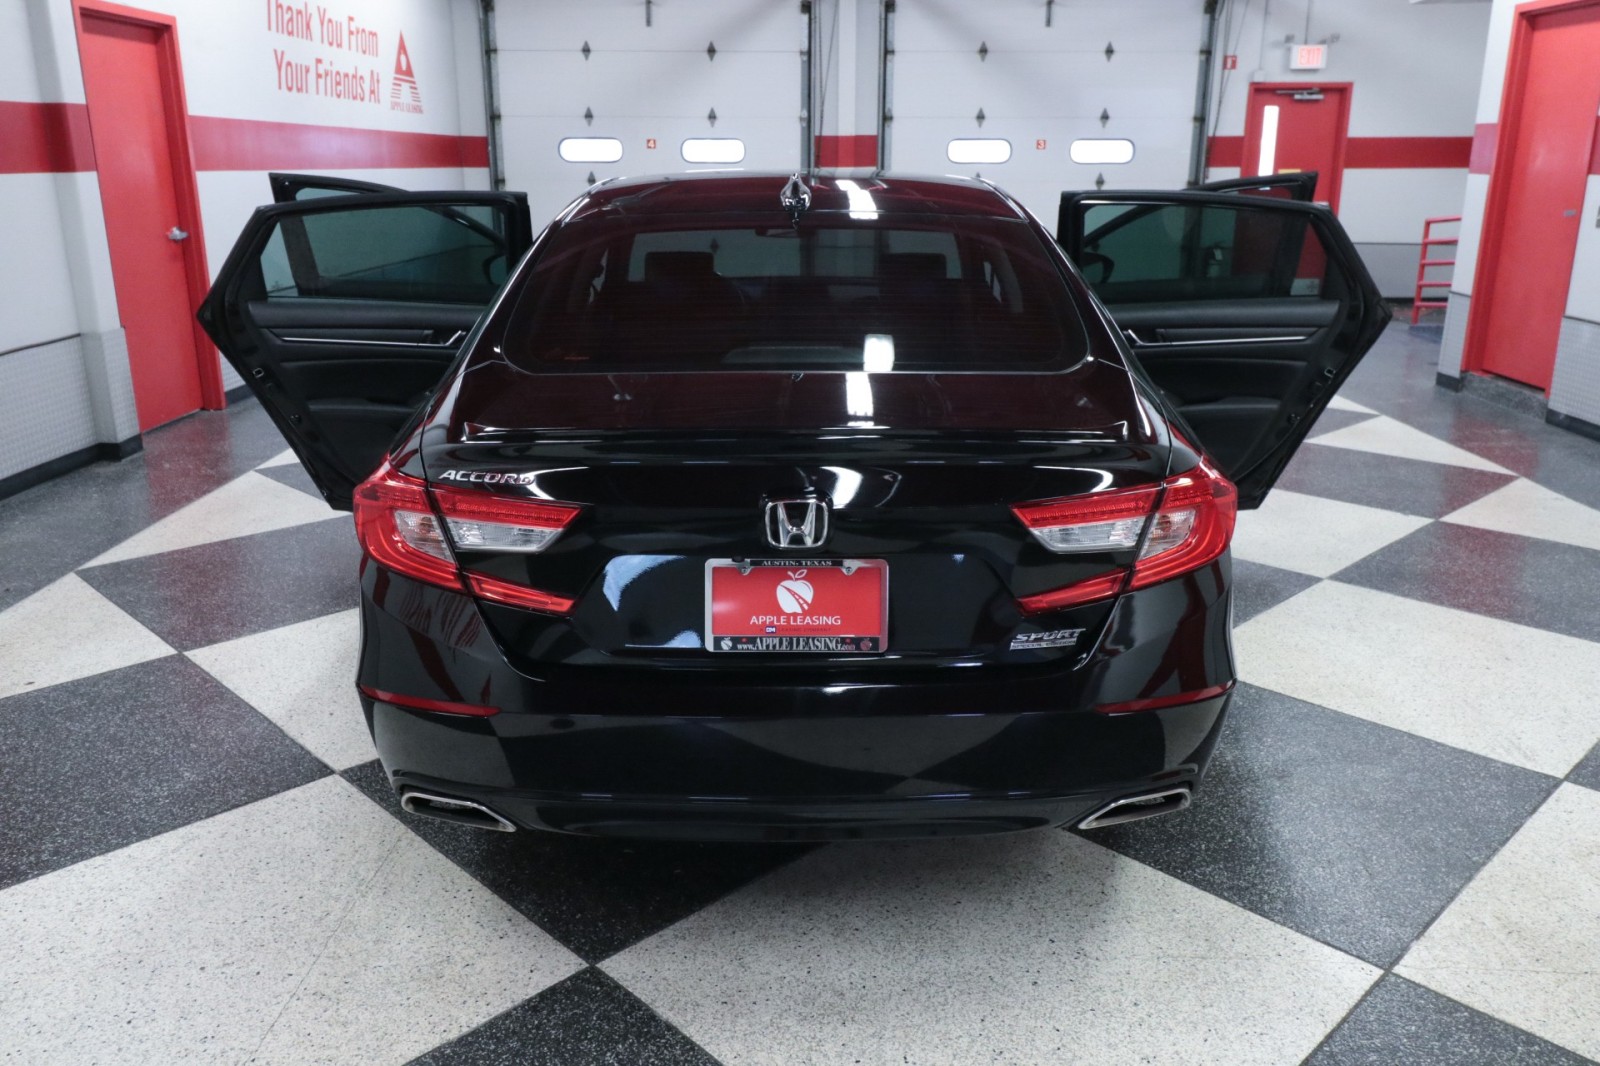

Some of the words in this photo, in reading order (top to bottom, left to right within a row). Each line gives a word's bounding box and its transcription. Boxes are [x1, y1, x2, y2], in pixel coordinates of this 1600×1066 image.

[266, 0, 313, 42] Thank
[317, 5, 343, 49] You
[347, 15, 379, 58] From
[273, 48, 311, 94] Your
[315, 57, 366, 103] Friends
[369, 69, 381, 105] At
[438, 469, 535, 486] ACCORD
[750, 615, 787, 625] APPLE
[790, 615, 841, 626] LEASING
[1012, 628, 1087, 642] SPORT
